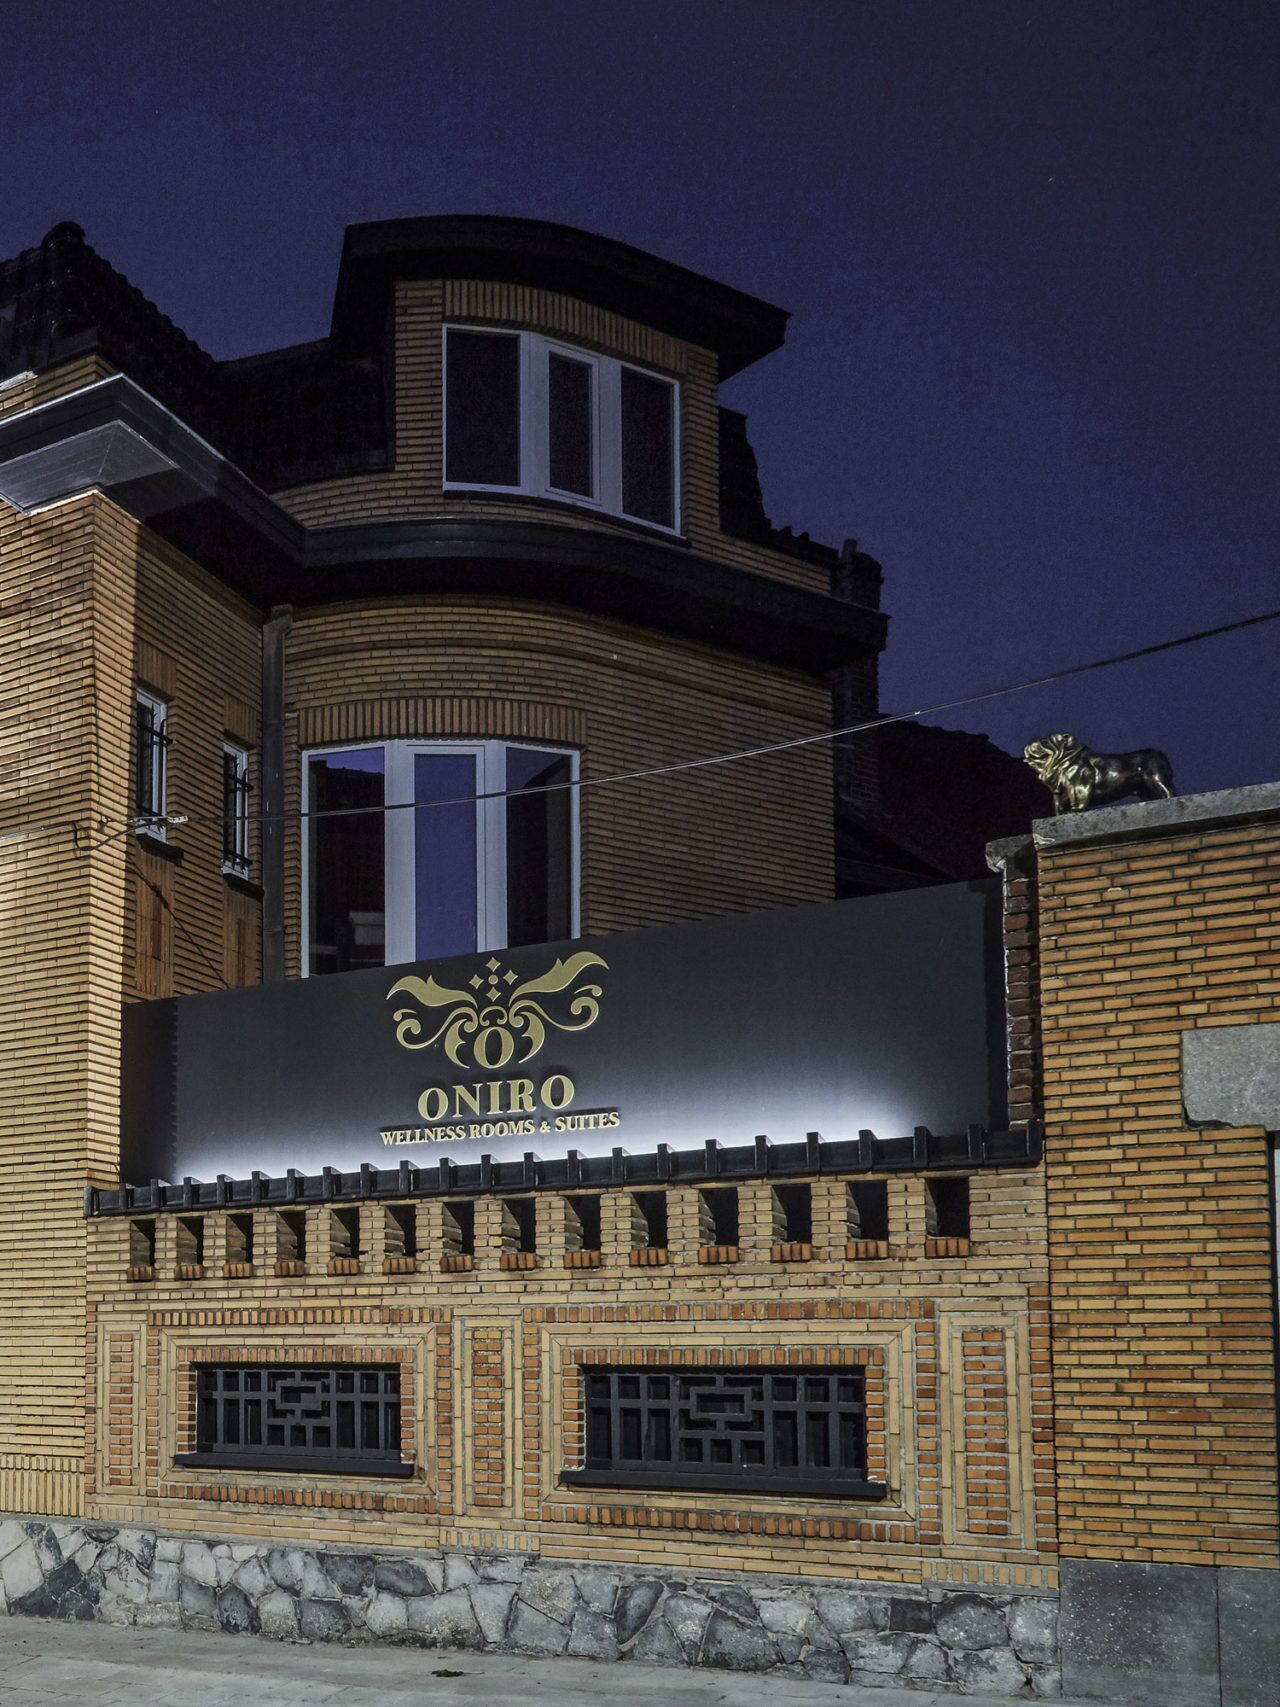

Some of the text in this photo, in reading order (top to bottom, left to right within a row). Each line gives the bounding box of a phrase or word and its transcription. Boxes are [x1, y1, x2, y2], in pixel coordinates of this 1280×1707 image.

[417, 1074, 575, 1121] ONIRO
[380, 1111, 621, 1146] WELLNESS ROOMS & SUITES
